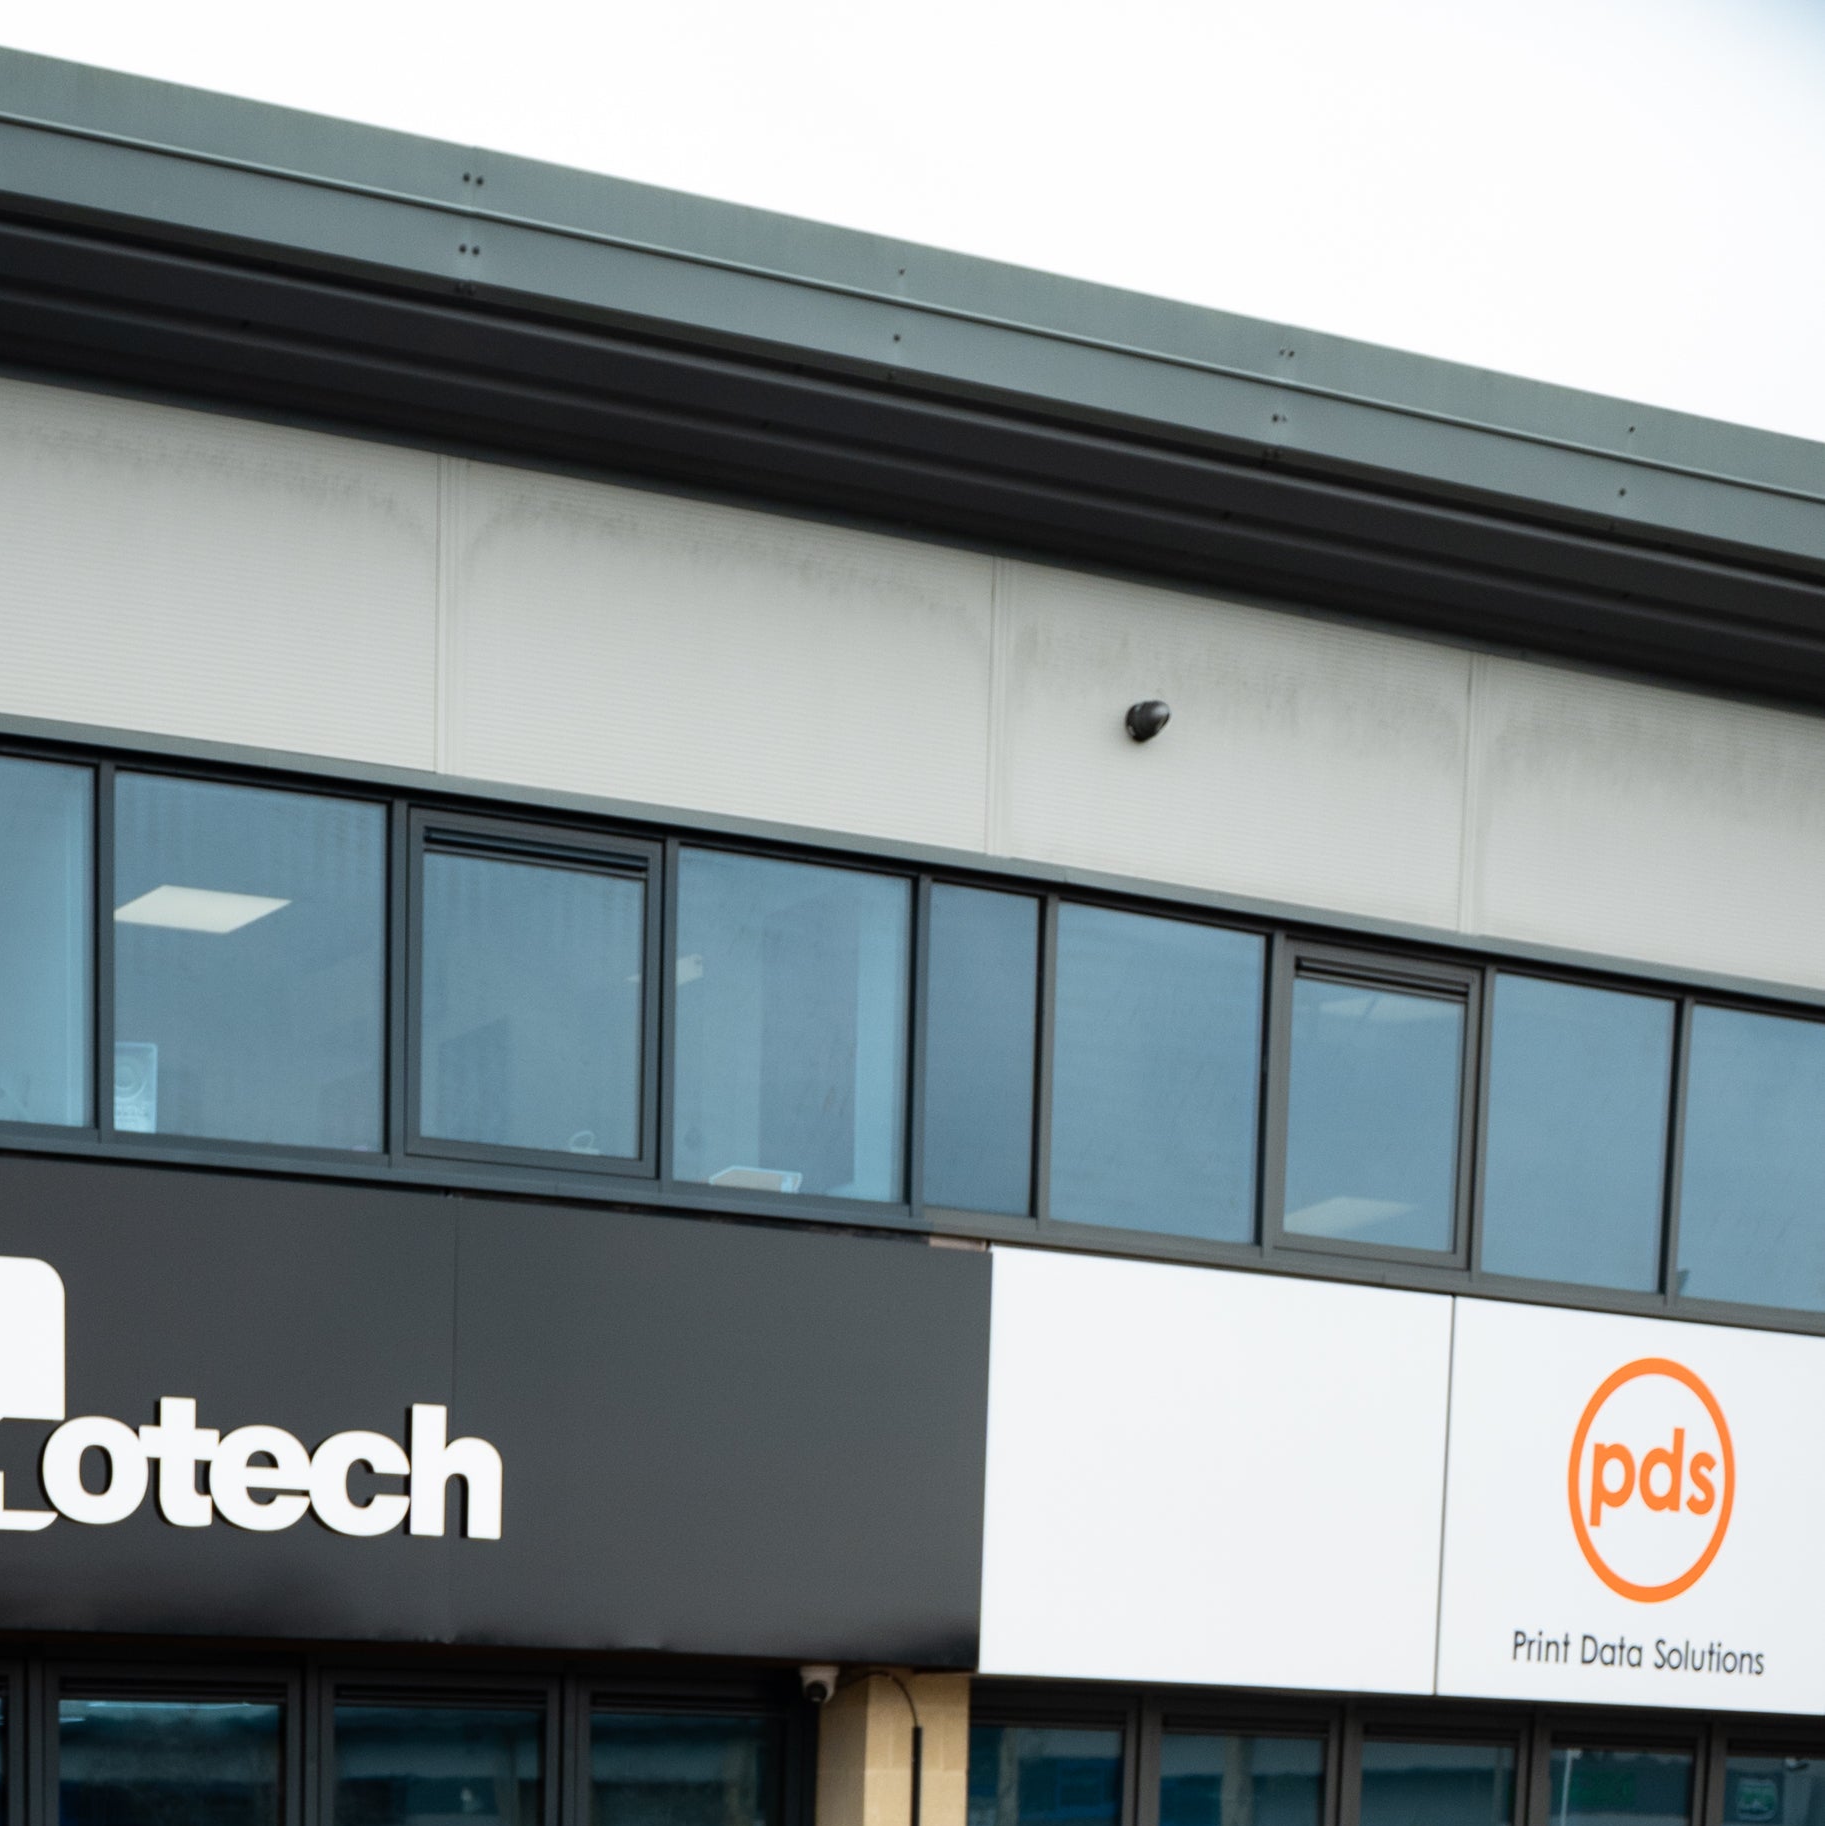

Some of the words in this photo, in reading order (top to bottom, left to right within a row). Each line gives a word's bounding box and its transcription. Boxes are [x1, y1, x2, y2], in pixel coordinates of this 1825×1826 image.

[1589, 1427, 1717, 1527] pds
[1512, 1629, 1570, 1663] Print
[1580, 1633, 1643, 1668] Data
[1653, 1638, 1765, 1676] Solutions
